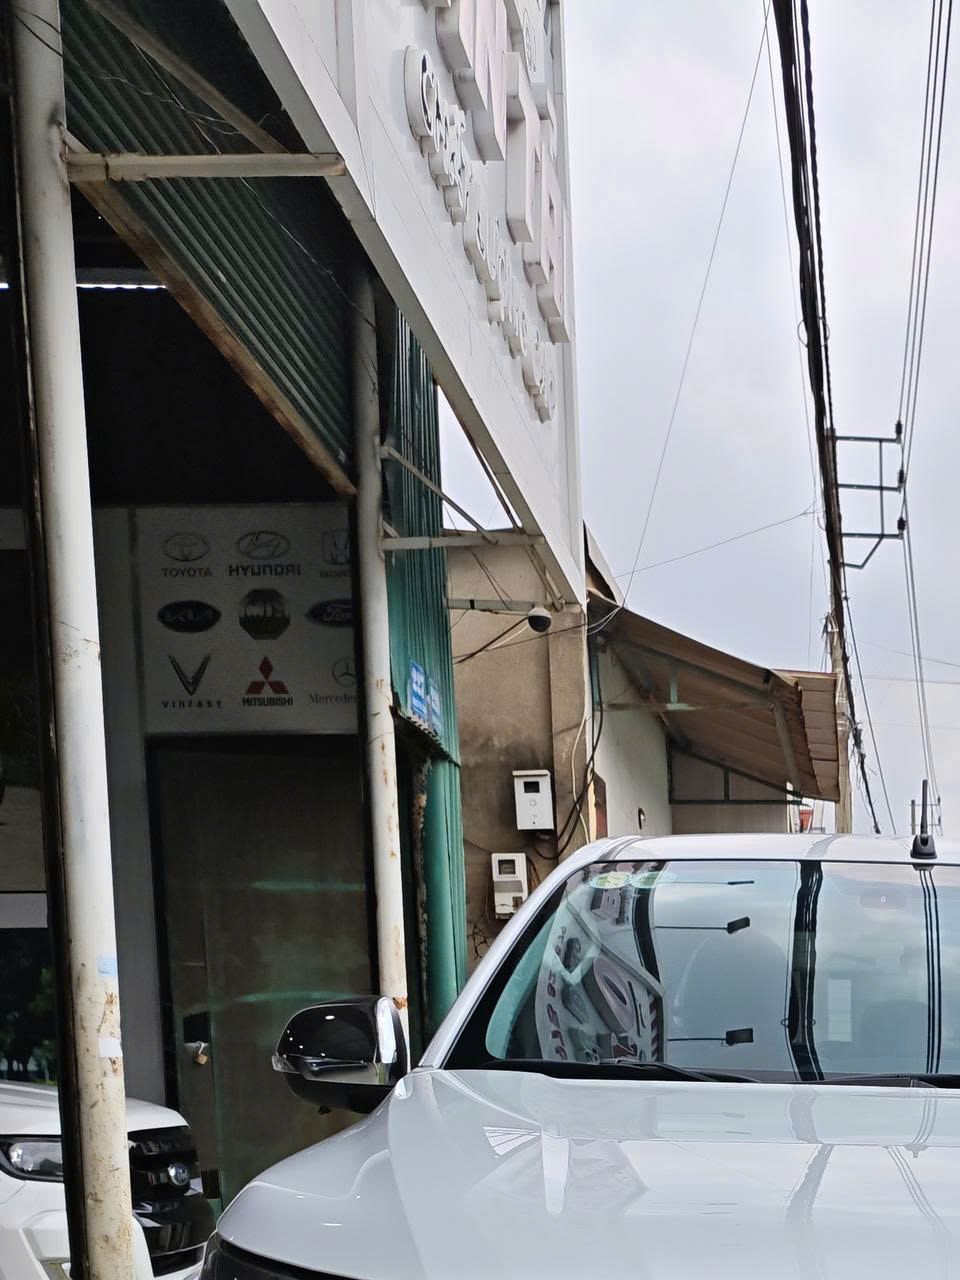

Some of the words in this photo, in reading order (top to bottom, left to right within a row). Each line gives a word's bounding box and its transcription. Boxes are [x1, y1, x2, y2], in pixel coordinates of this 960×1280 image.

[161, 567, 213, 578] TOYOTA
[228, 564, 301, 577] HYUNDAI
[161, 700, 222, 709] VINFAST
[242, 697, 294, 707] MITSUBISHI
